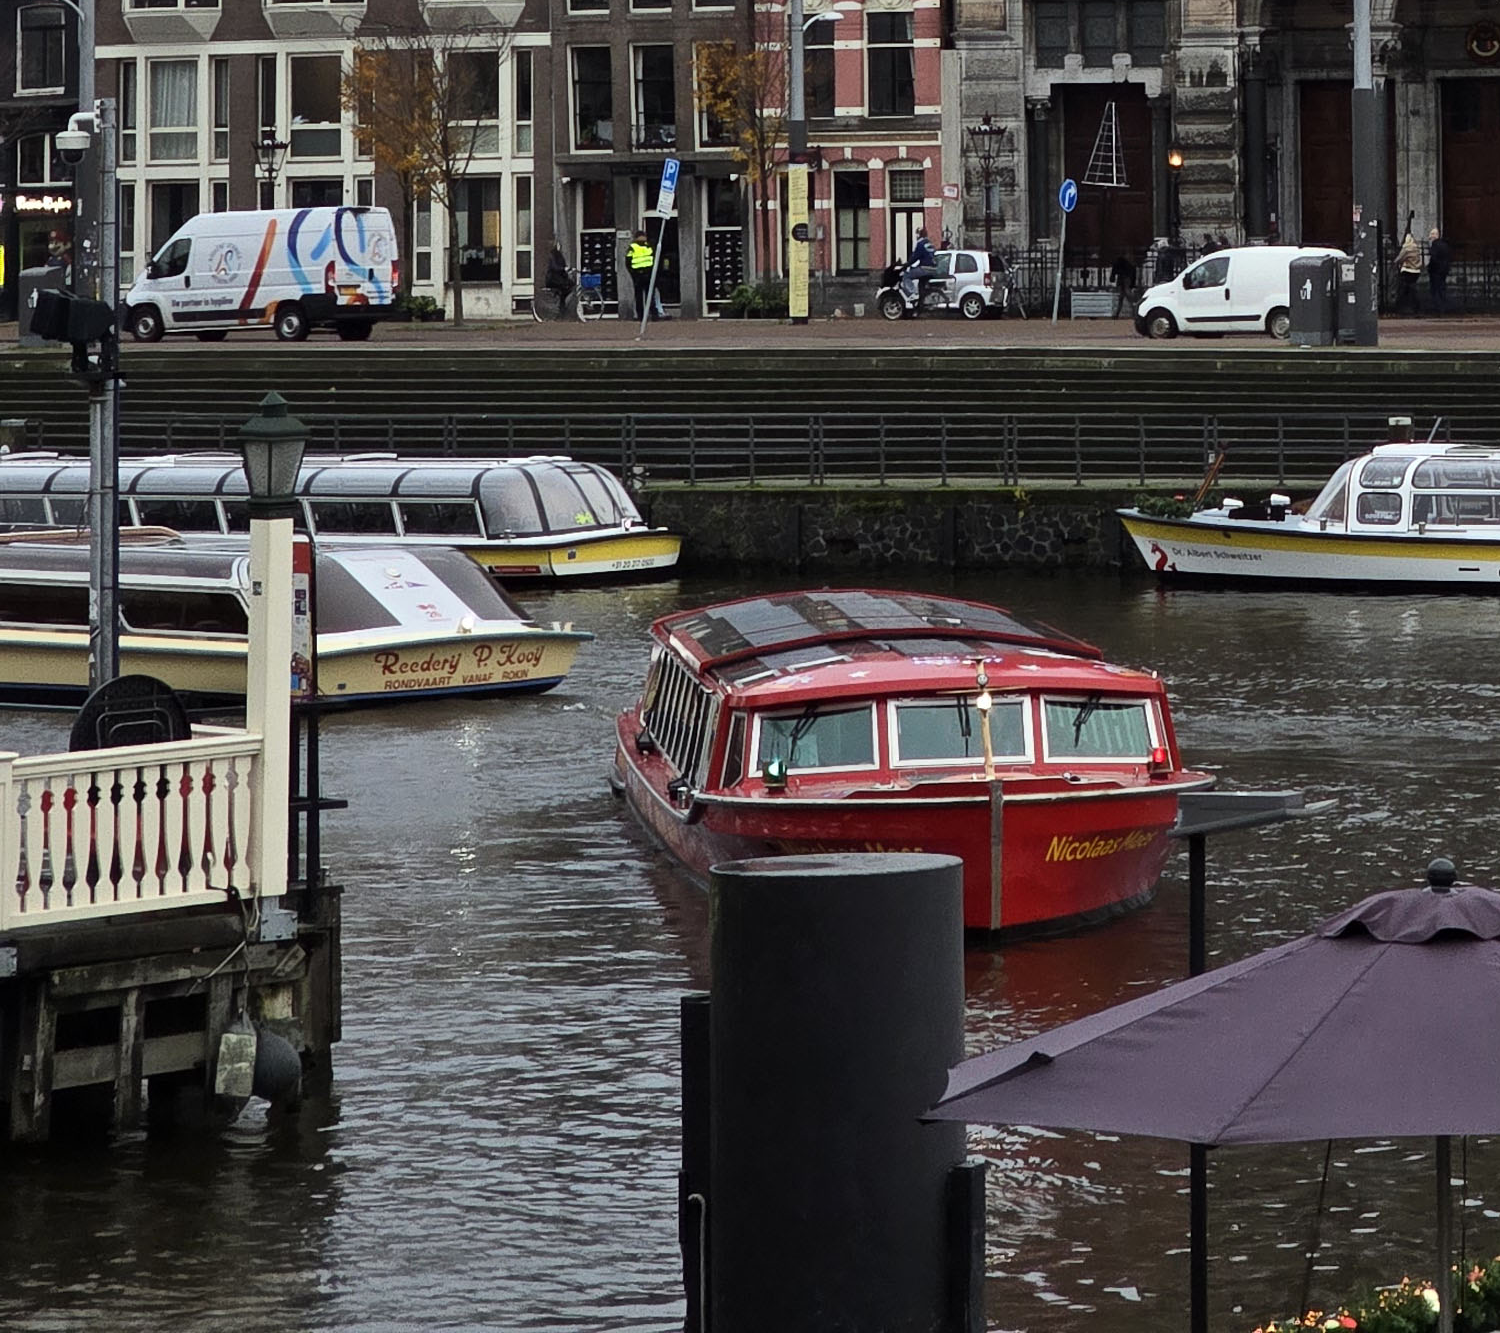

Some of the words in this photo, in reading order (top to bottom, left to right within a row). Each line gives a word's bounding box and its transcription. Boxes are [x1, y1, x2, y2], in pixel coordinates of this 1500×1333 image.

[384, 676, 452, 690] RONDVAART
[462, 673, 494, 684] VANAF
[1045, 835, 1120, 862] Nicolaas
